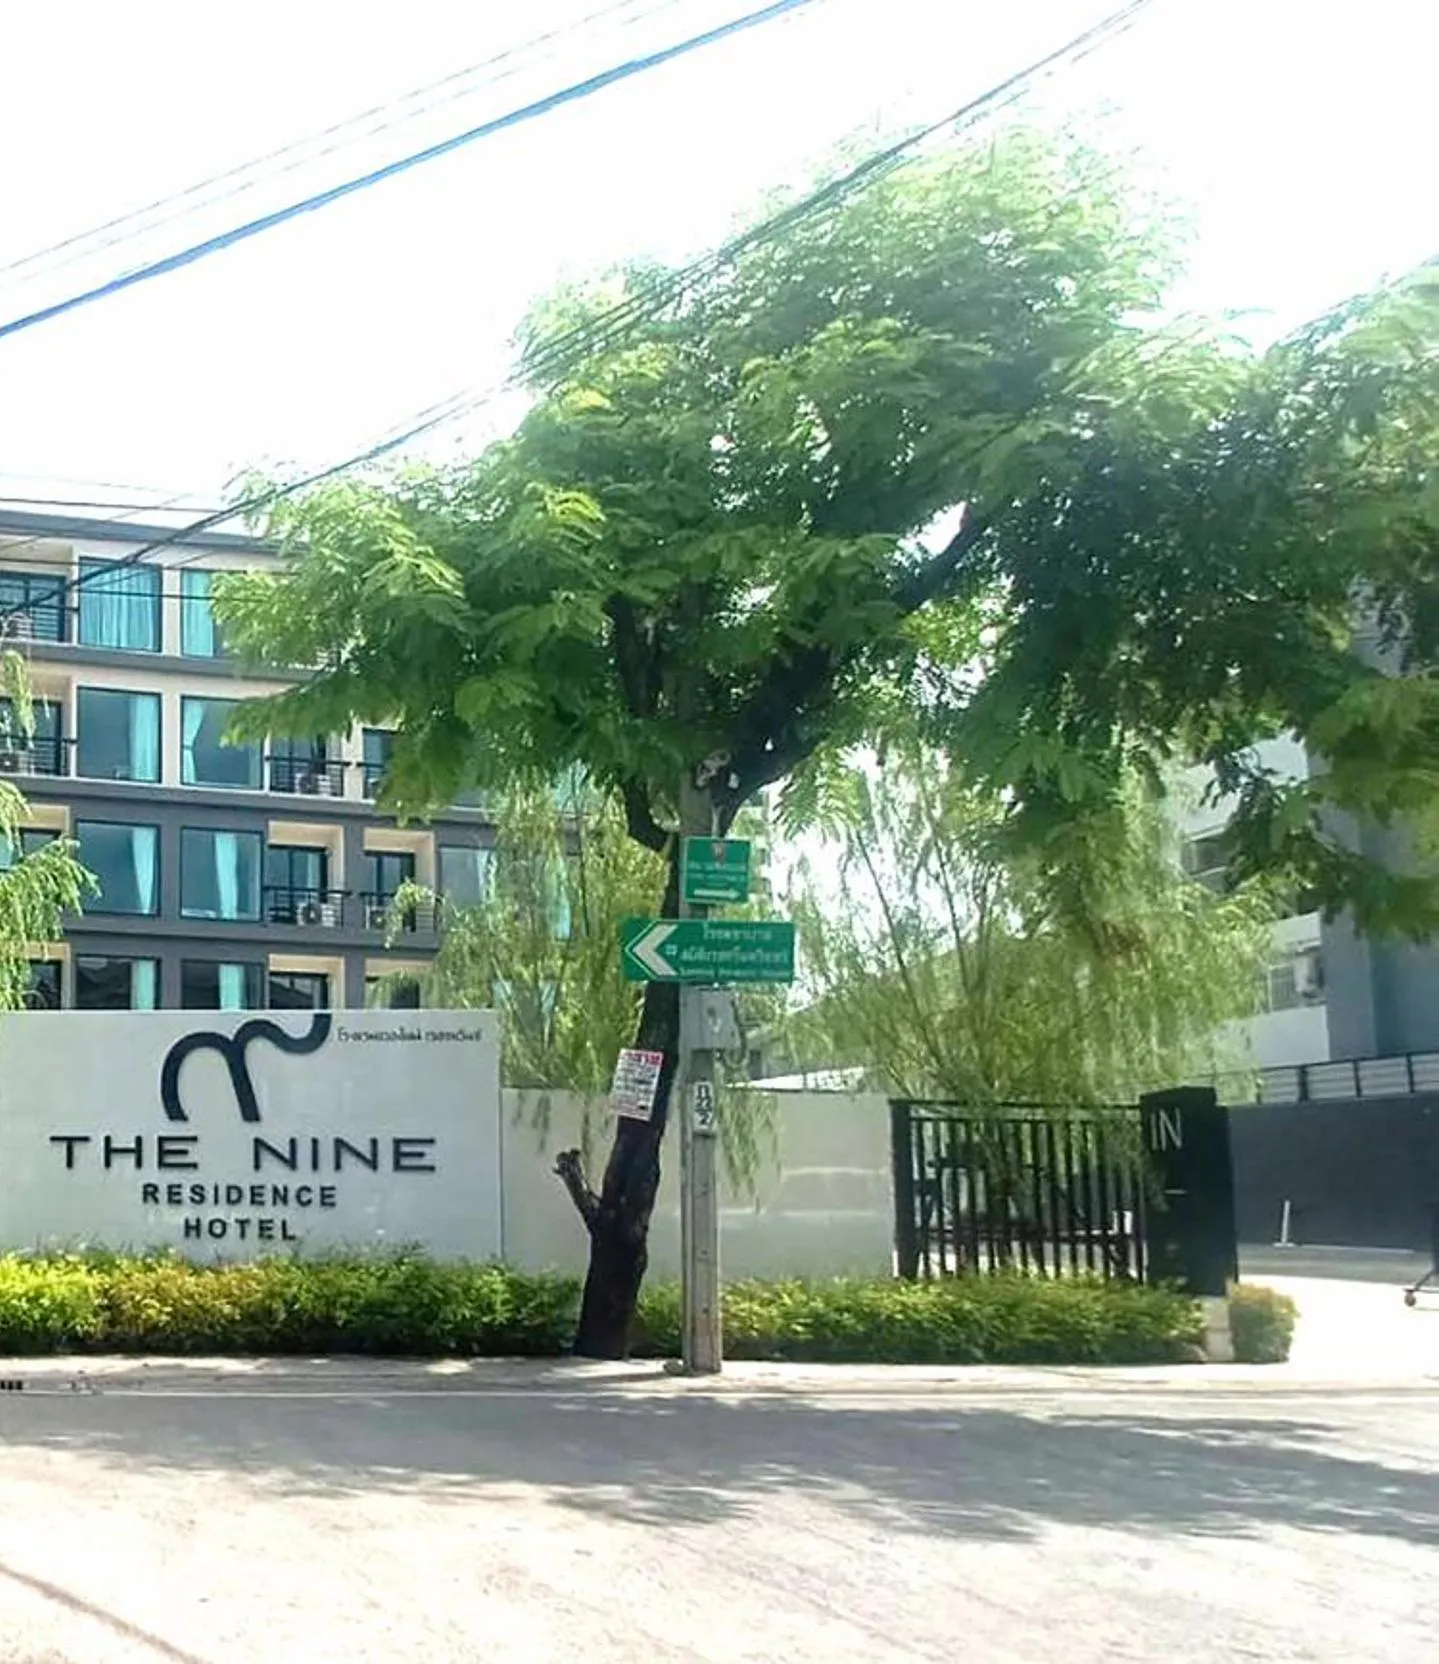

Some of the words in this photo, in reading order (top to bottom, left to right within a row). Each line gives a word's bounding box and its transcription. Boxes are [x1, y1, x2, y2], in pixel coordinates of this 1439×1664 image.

[1150, 1106, 1183, 1151] IN
[49, 1135, 200, 1171] THE
[253, 1137, 438, 1173] NINE
[142, 1182, 338, 1208] RESIDENCE
[183, 1217, 297, 1241] HOTEL
